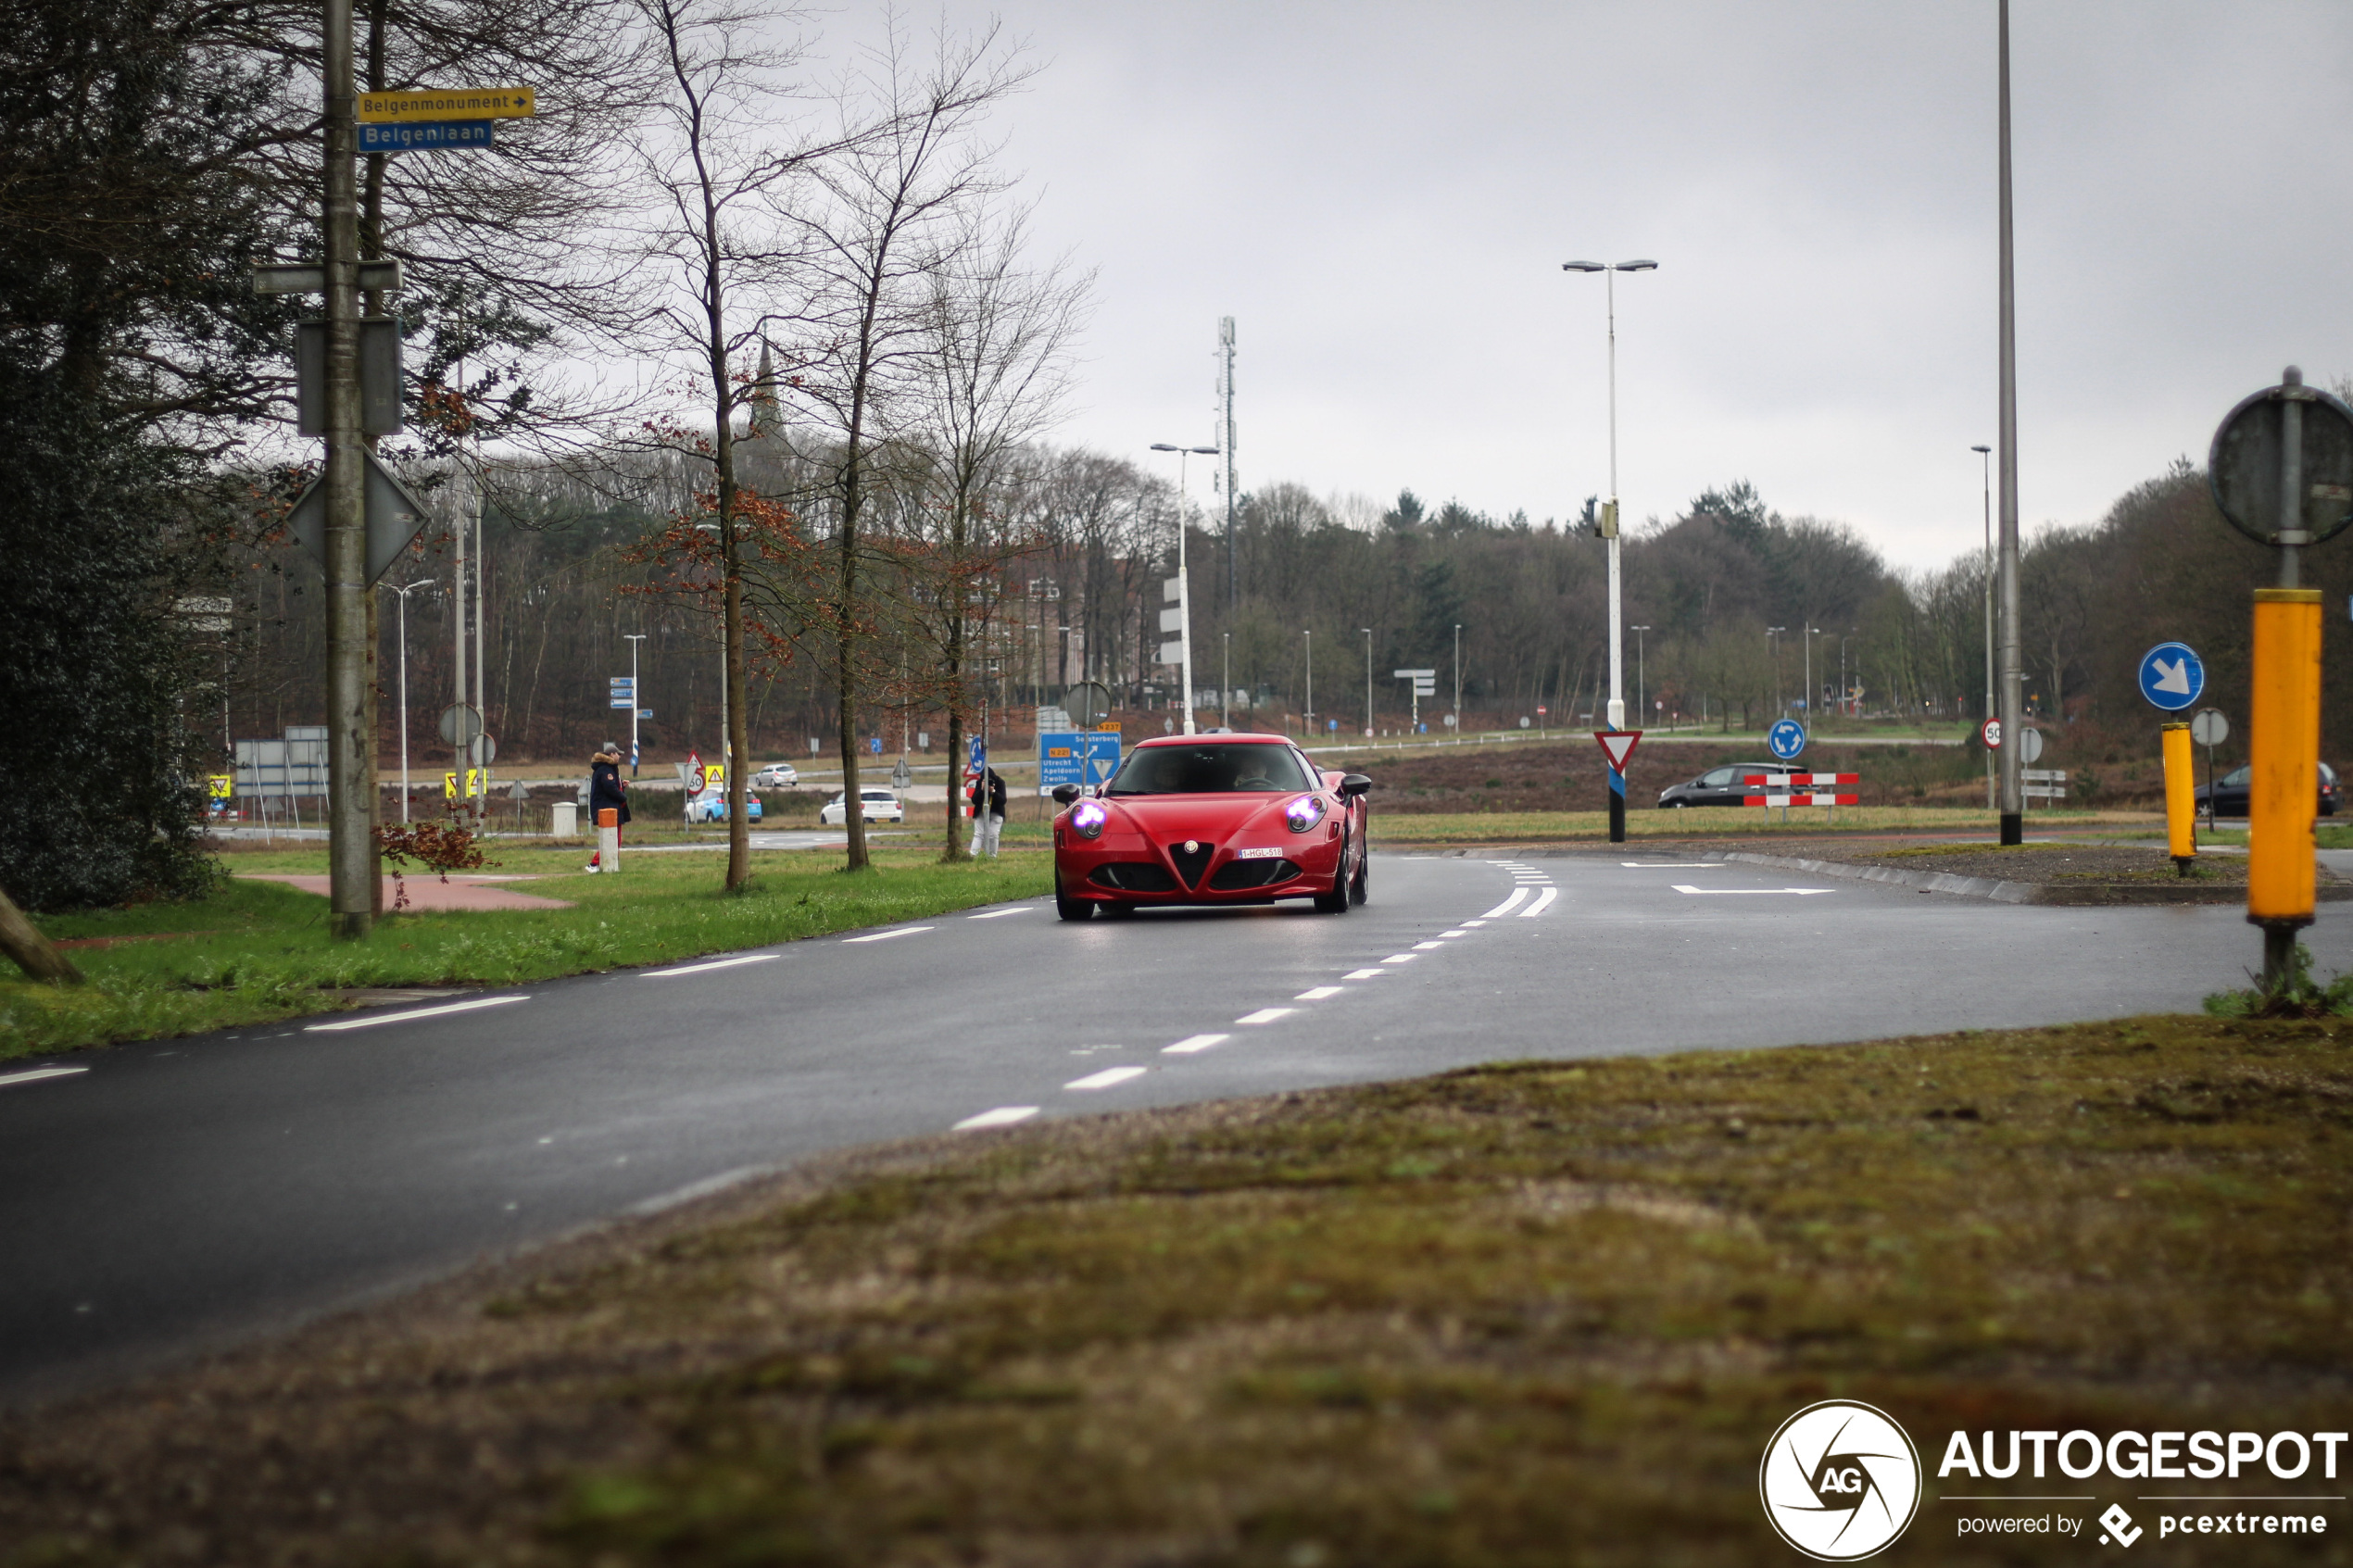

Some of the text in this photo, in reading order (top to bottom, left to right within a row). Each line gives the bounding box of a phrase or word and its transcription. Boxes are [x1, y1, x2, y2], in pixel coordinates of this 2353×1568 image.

[364, 96, 509, 115] Belgenmonument
[366, 127, 484, 146] Belgenlaan
[1242, 847, 1282, 858] 1-HGL-518
